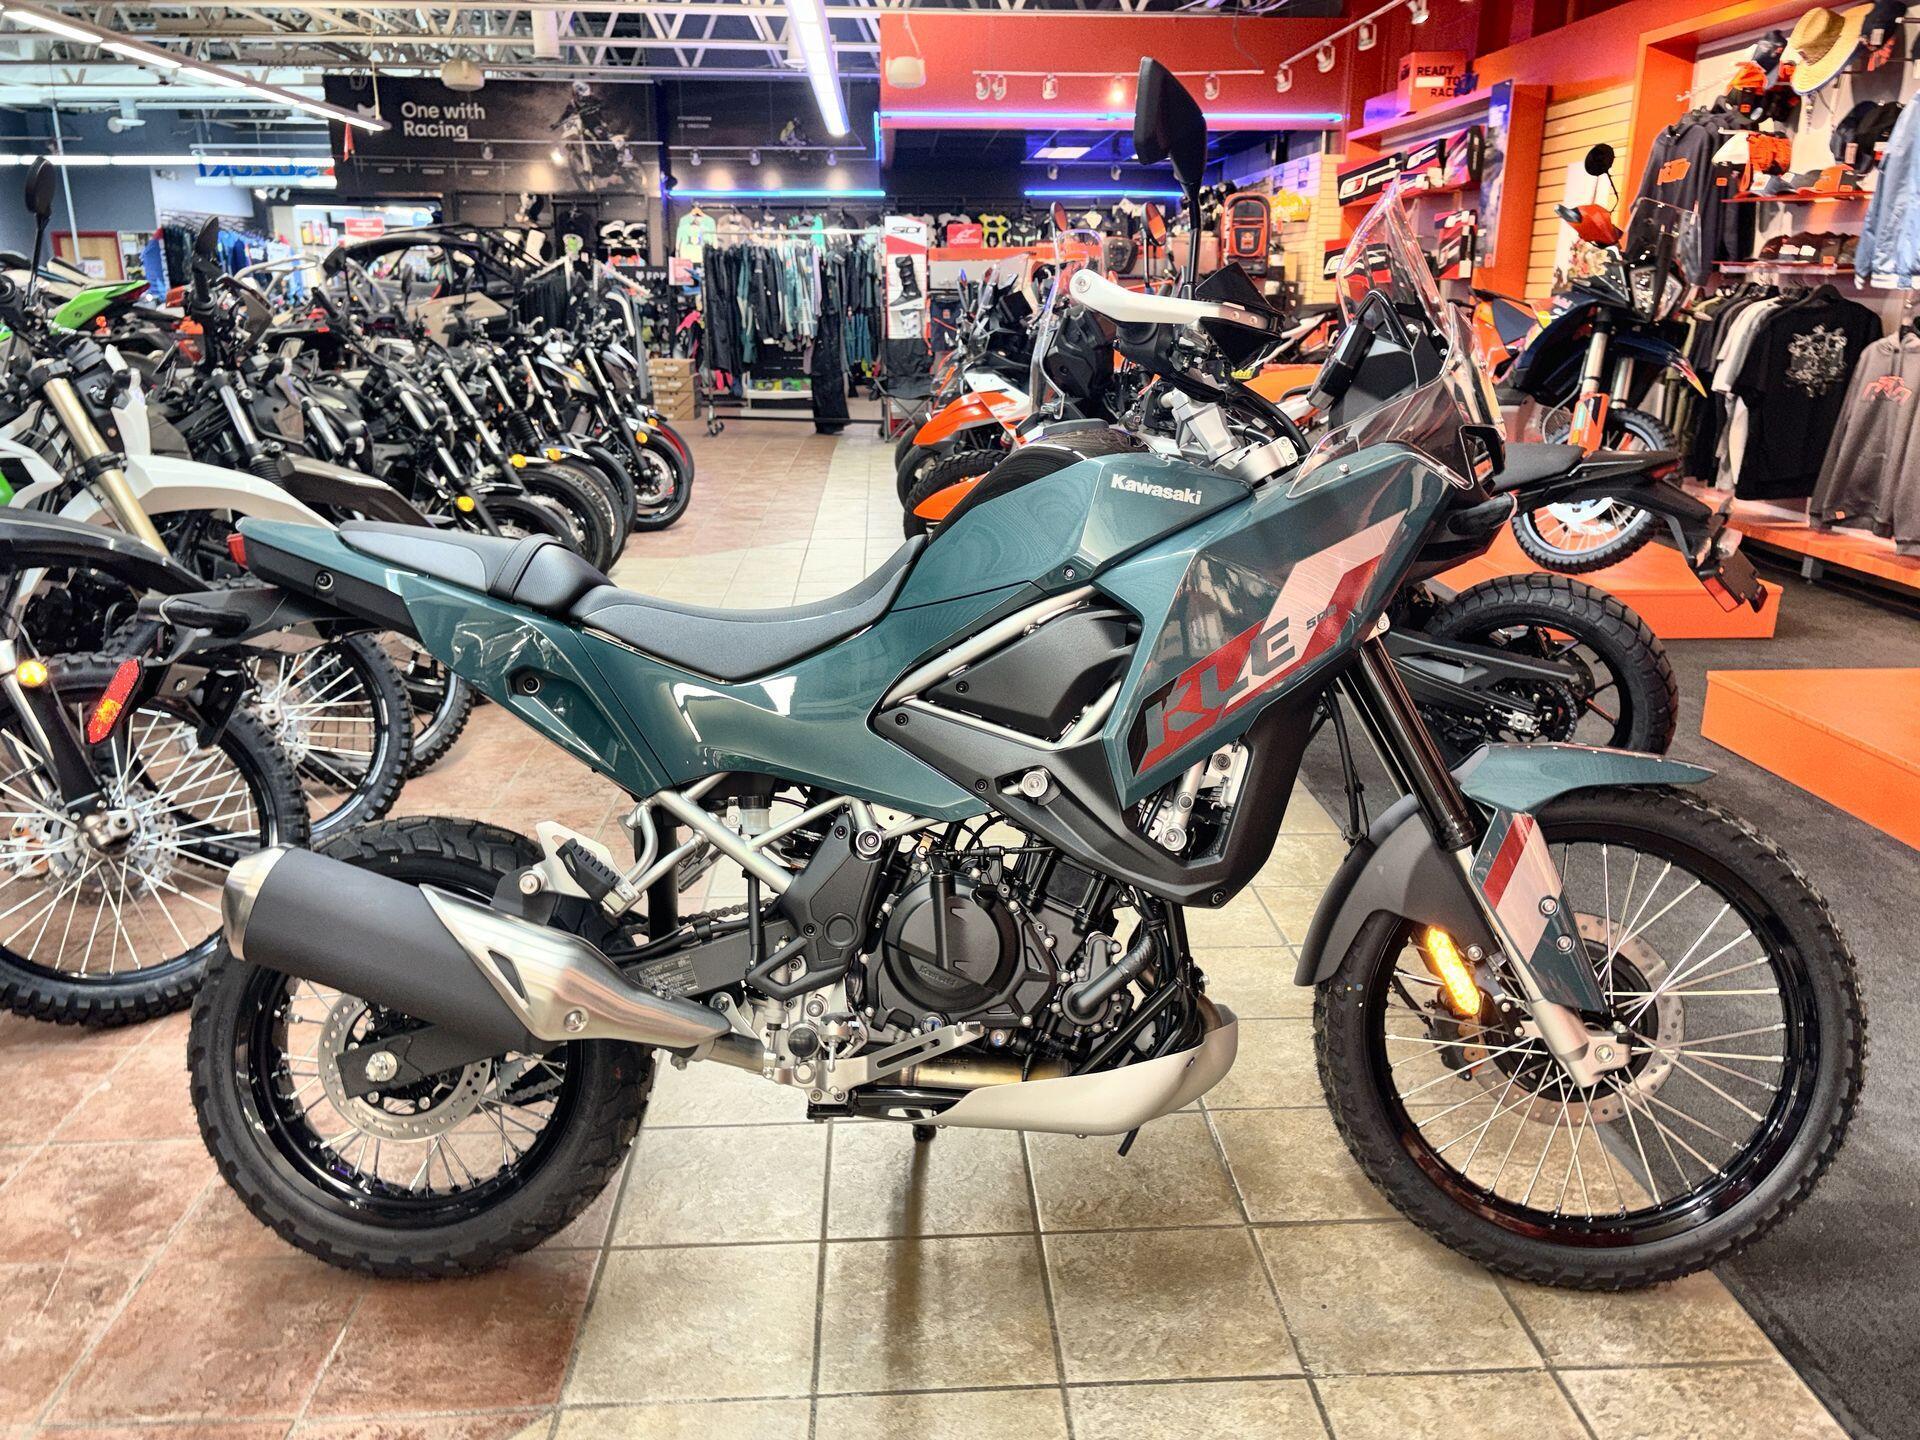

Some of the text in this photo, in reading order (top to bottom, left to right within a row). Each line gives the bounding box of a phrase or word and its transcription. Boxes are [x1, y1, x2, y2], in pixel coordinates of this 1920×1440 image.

[1416, 64, 1455, 76] READY
[1430, 87, 1455, 97] RAC
[401, 101, 485, 120] One with
[403, 120, 468, 139] Racing
[1110, 473, 1202, 505] Kawasaki
[1145, 616, 1296, 749] KLE
